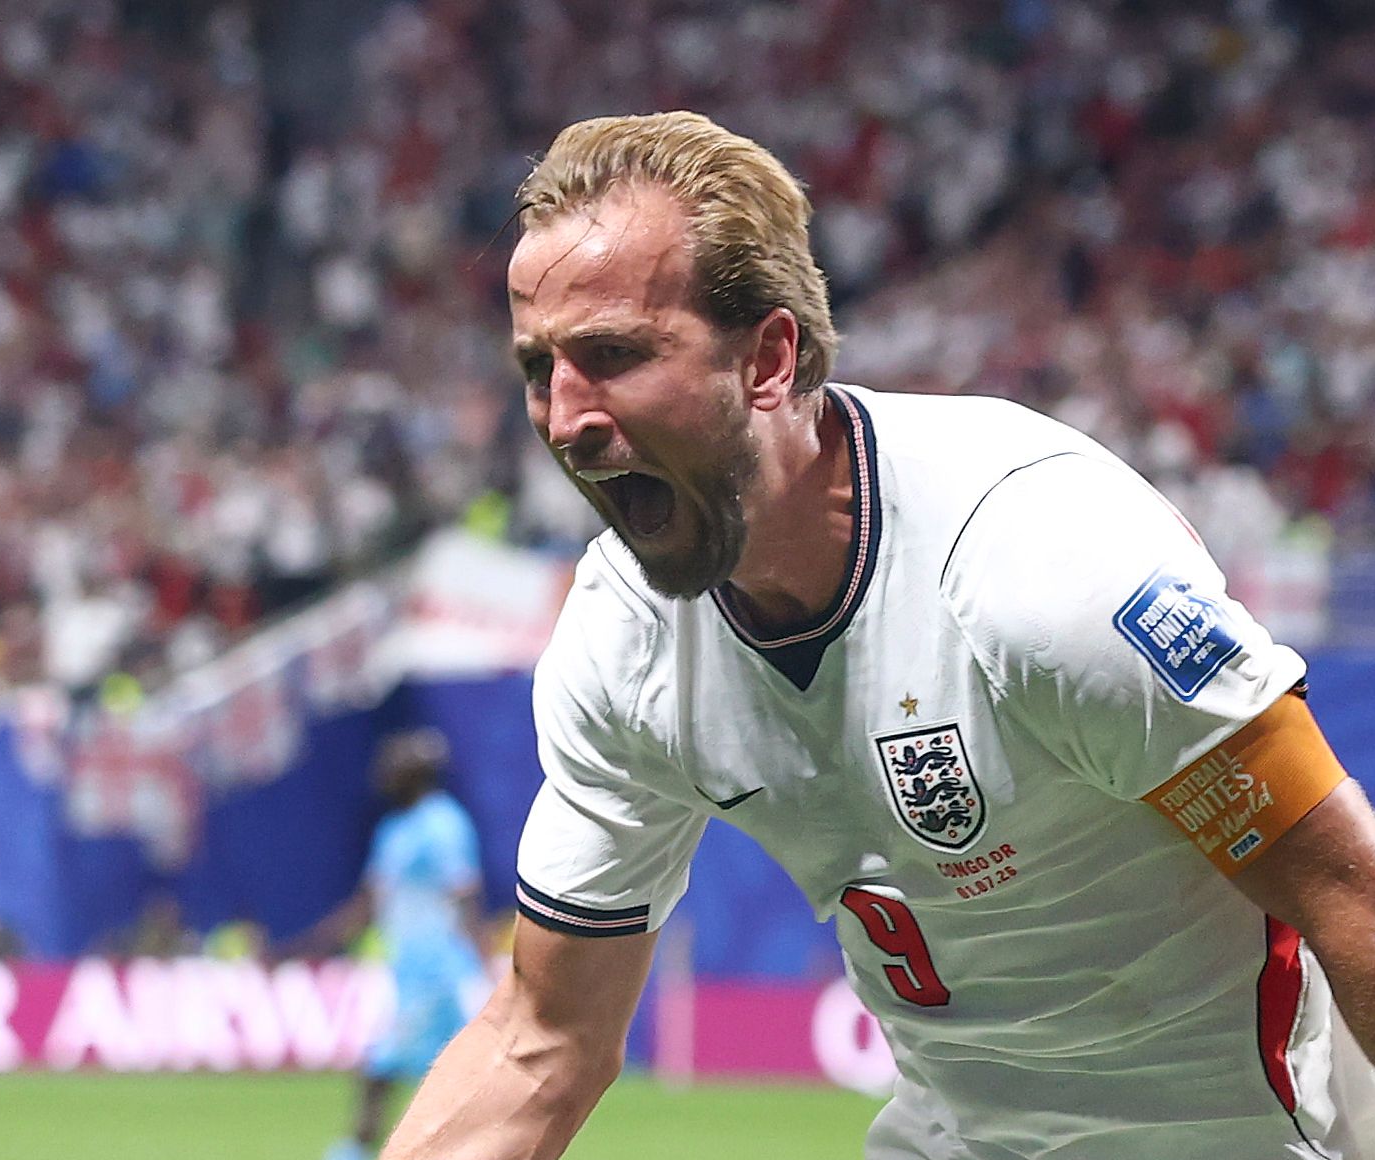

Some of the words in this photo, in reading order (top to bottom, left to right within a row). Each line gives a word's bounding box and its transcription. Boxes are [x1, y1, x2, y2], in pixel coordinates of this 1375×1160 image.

[1148, 596, 1204, 650] UNITES
[1159, 749, 1238, 812] FOOTBALL
[1176, 763, 1254, 832] UNITES
[1218, 780, 1273, 839] World
[956, 866, 1017, 899] 01.07.26
[988, 843, 1017, 864] DR
[839, 886, 951, 1007] 9
